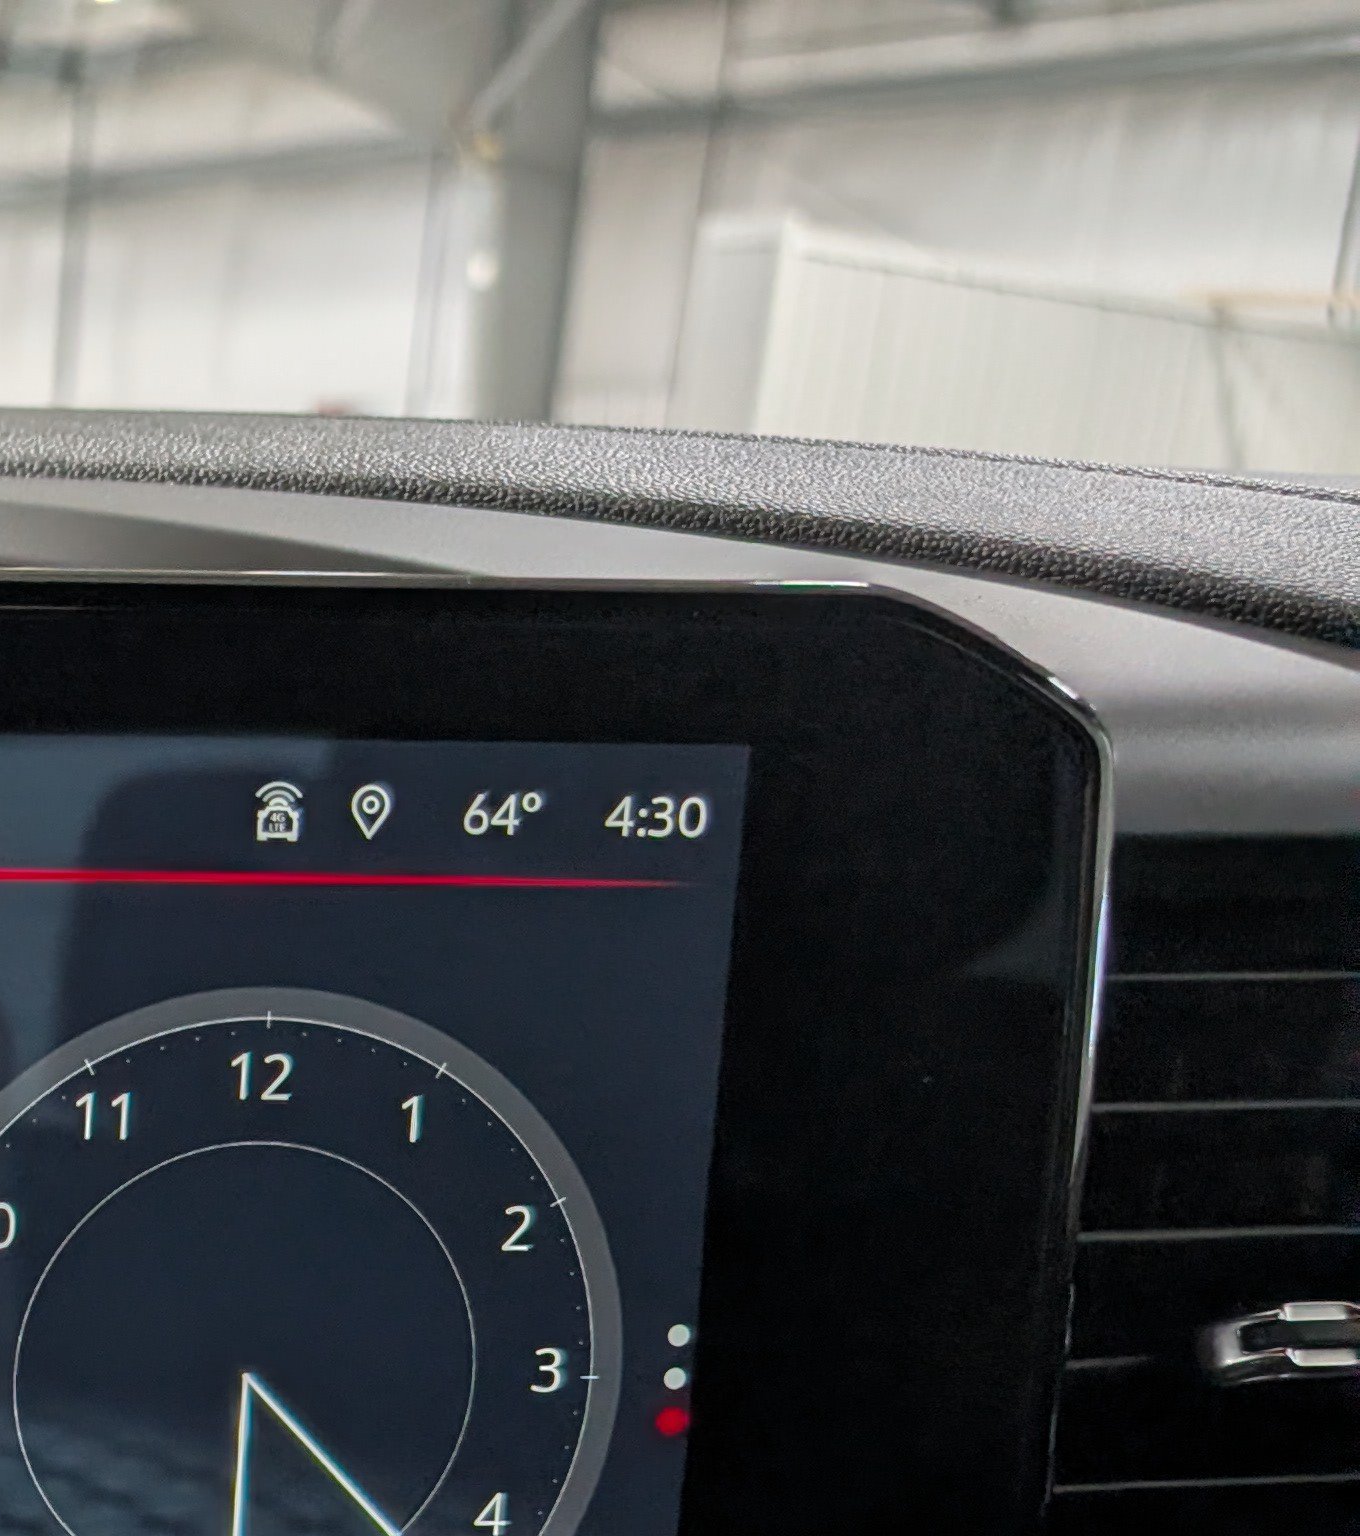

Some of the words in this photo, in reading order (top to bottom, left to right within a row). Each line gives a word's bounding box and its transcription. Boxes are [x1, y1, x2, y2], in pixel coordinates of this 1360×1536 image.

[462, 790, 544, 837] 64°
[603, 794, 709, 839] 4:30
[230, 1051, 293, 1102] 12
[75, 1091, 131, 1142] 11
[400, 1094, 424, 1144] 1
[500, 1204, 536, 1253] 2
[529, 1346, 565, 1394] 3
